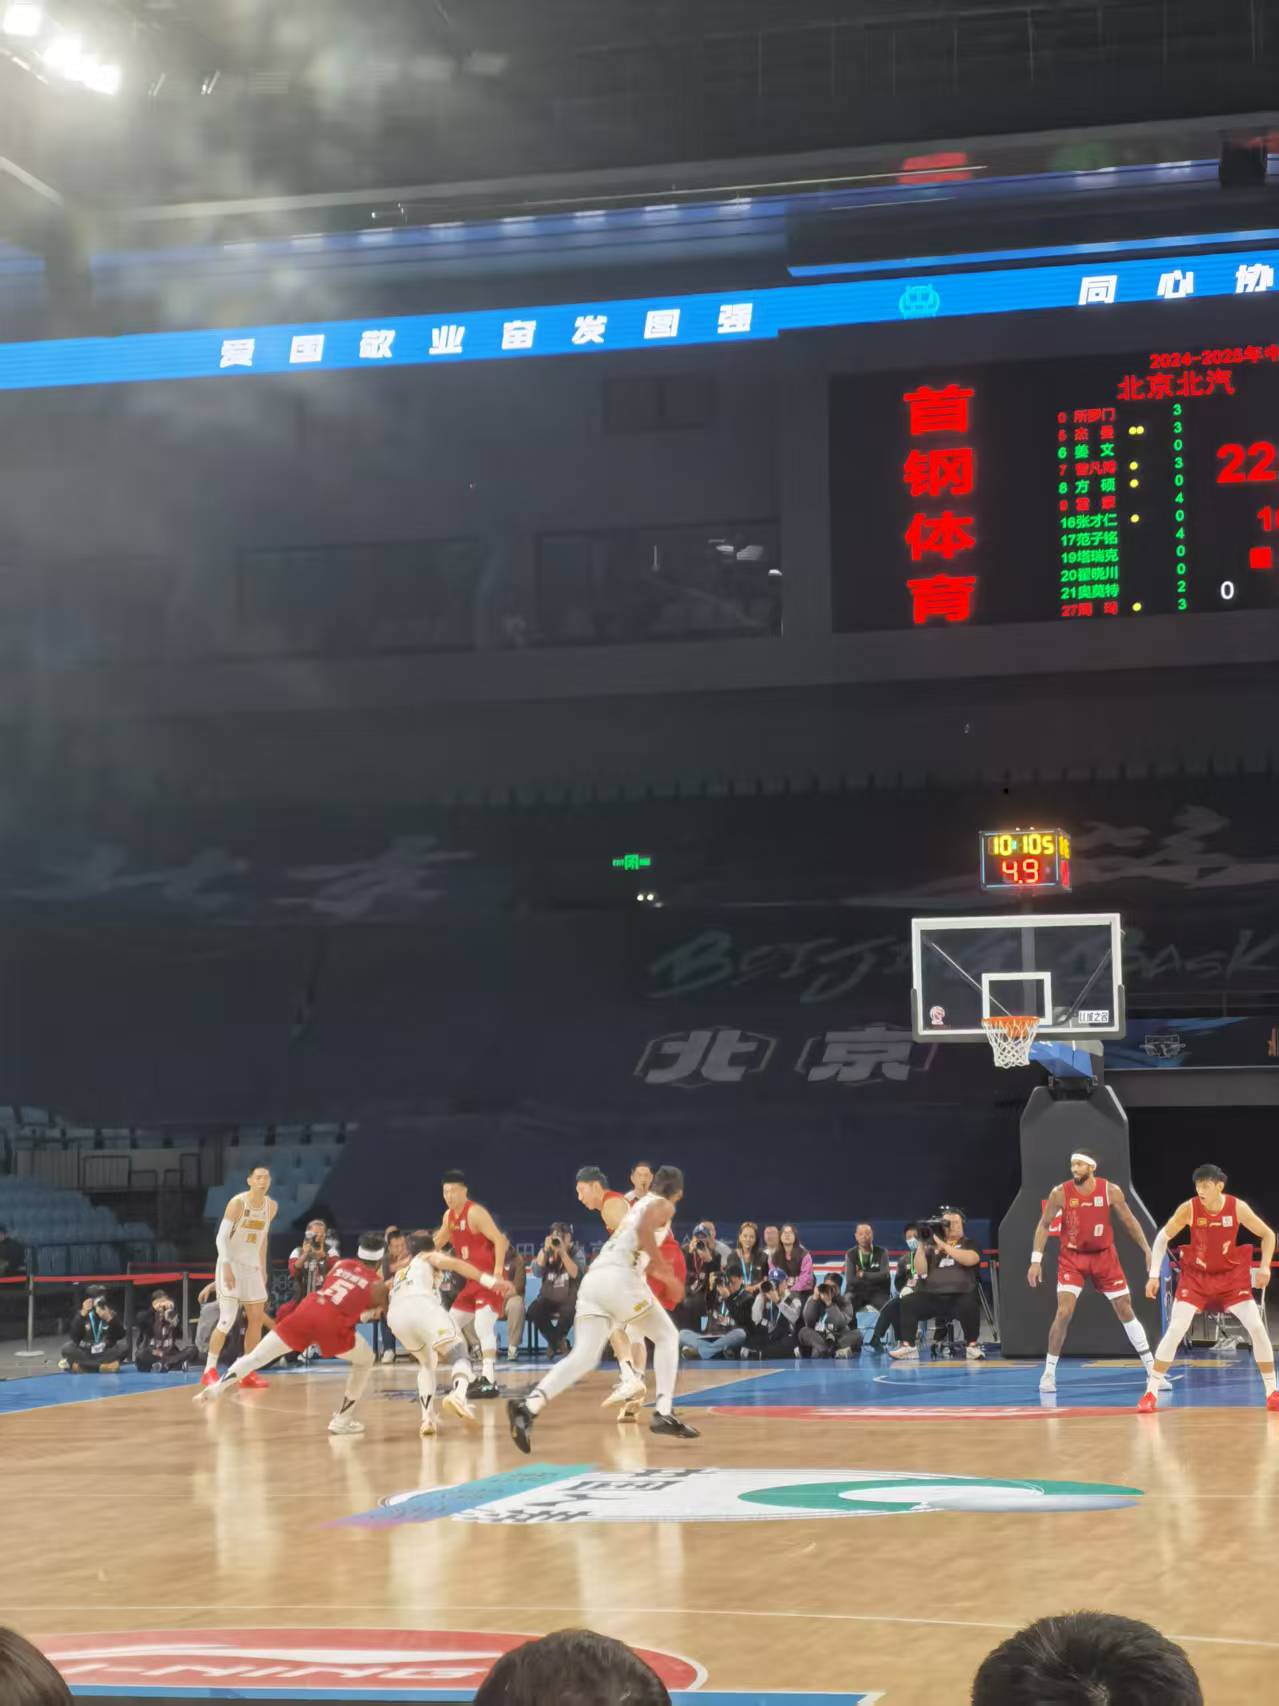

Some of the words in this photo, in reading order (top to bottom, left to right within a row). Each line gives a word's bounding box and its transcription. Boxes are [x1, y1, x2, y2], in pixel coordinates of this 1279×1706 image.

[1117, 367, 1235, 400] 北京北汽
[1174, 404, 1182, 416] 3
[1174, 422, 1182, 434] 3
[1174, 439, 1183, 451] 0
[1175, 457, 1183, 469] 3
[1216, 441, 1277, 483] 22
[1059, 481, 1068, 494] 8
[1175, 474, 1184, 486] 0
[903, 383, 976, 625] 首钢体育
[1175, 492, 1184, 503] 4
[1176, 509, 1185, 522] 0
[1257, 505, 1279, 532] 1
[1176, 527, 1185, 539] 4
[1176, 545, 1185, 557] 0
[1177, 562, 1186, 575] 0
[1177, 580, 1186, 592] 2
[1220, 581, 1235, 600] 0
[1178, 598, 1187, 610] 3
[1002, 858, 1039, 883] 4.9
[58, 1663, 488, 1679] I-NING
